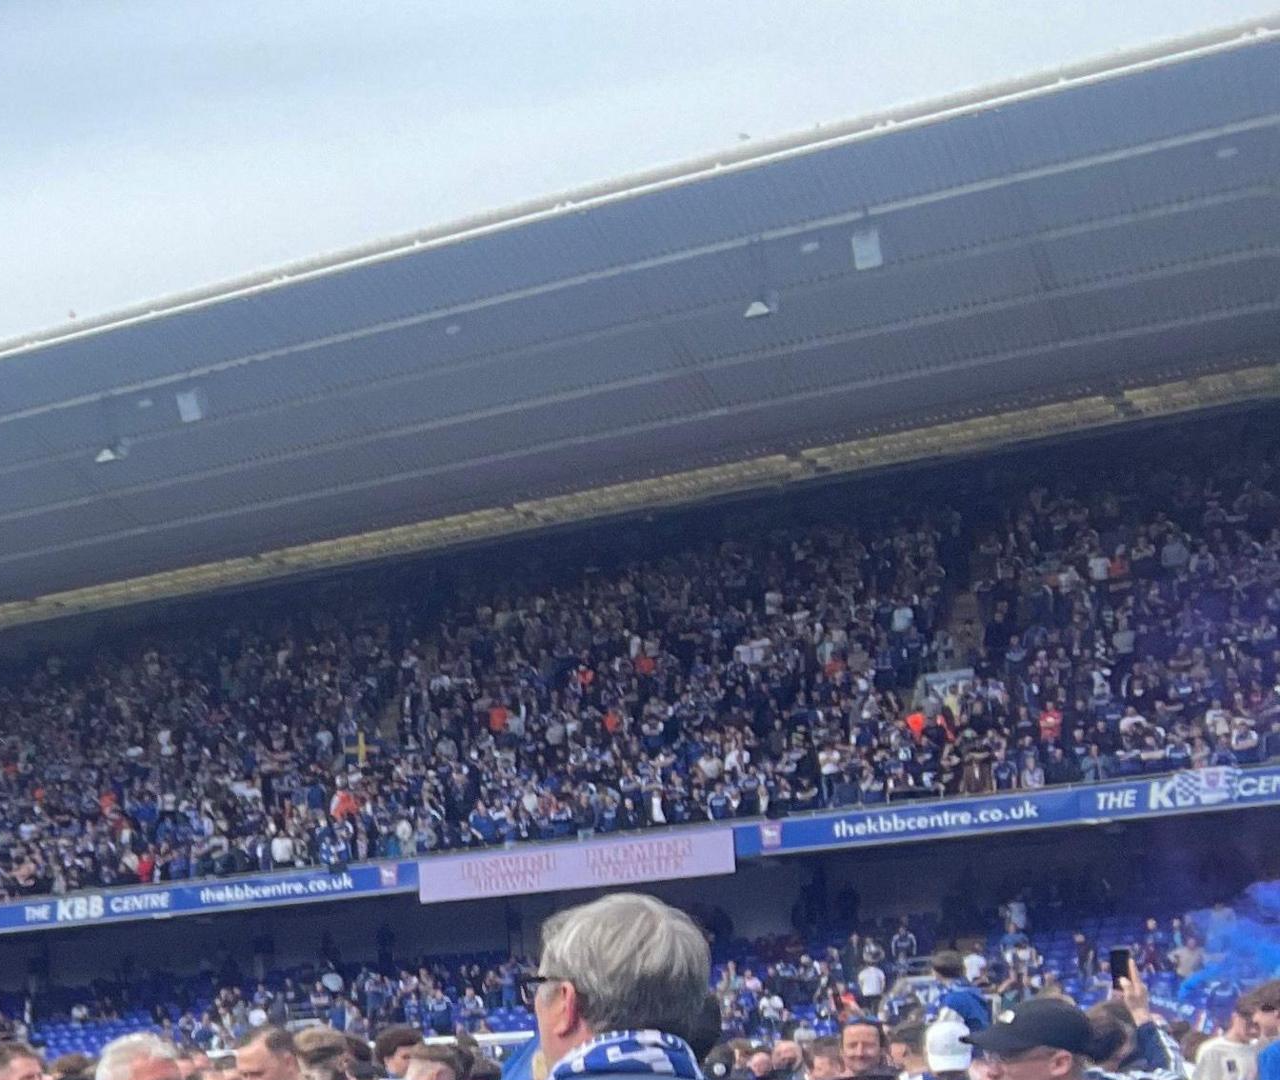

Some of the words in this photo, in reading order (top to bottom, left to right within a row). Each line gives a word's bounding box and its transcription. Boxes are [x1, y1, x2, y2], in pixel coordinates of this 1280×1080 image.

[1096, 789, 1138, 810] THE
[833, 802, 1039, 839] thekbbcentre.co.uk
[200, 872, 354, 904] thekbbcentre.co.uk
[25, 903, 50, 922] THE
[56, 895, 104, 922] KBB
[110, 891, 171, 914] CENTRE
